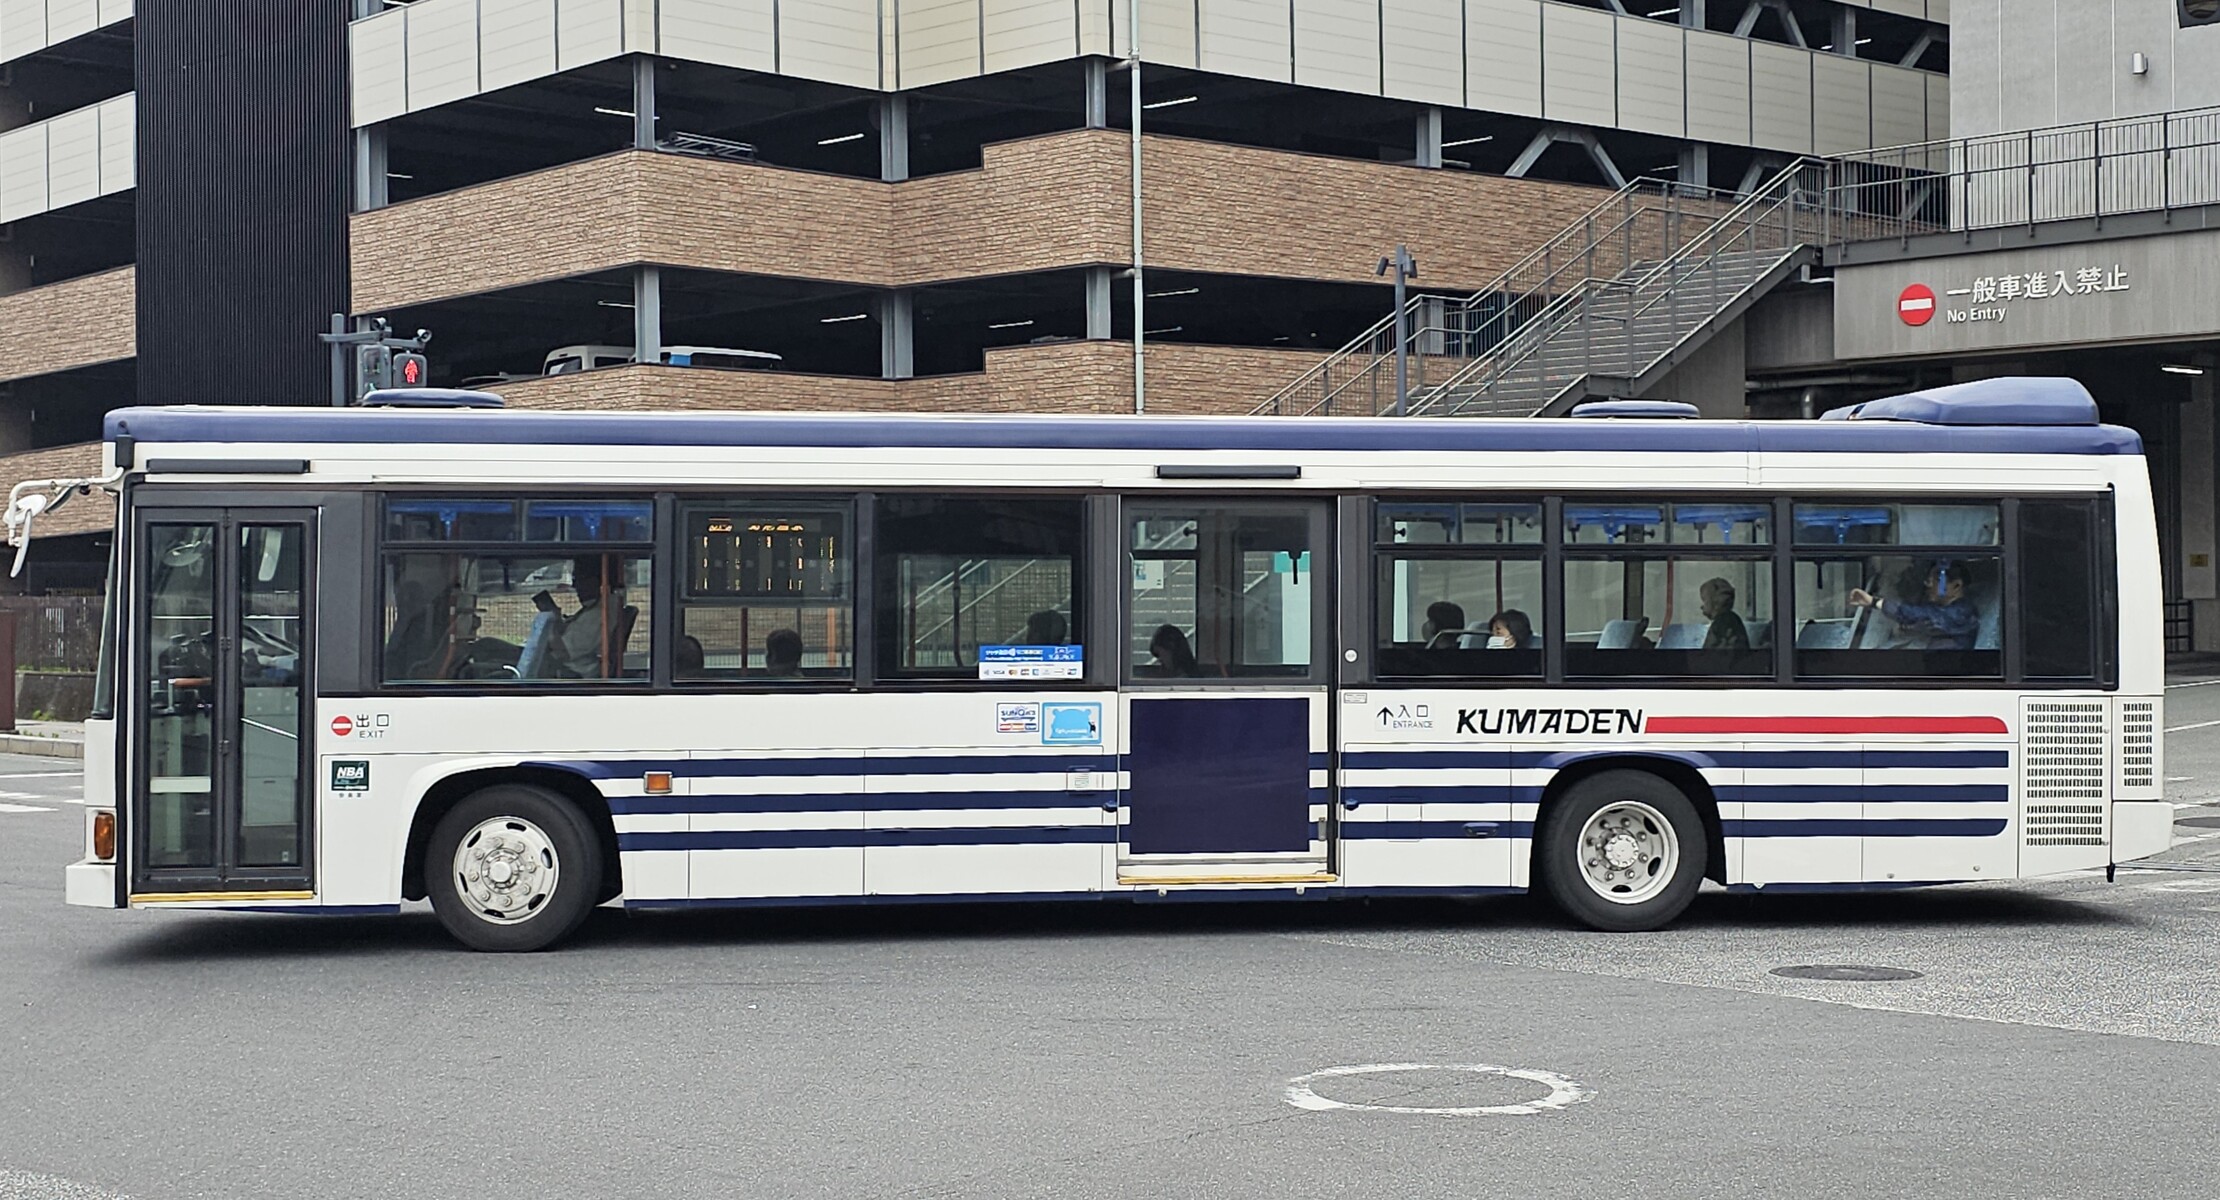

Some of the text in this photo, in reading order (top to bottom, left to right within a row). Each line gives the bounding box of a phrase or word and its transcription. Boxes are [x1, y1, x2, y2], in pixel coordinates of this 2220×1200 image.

[1946, 264, 2130, 304] 一般車進入禁止
[1946, 307, 2006, 323] No Entry
[1398, 705, 1428, 718] 入口
[356, 714, 389, 727] 出口
[1393, 720, 1433, 729] ENTRANCE
[1456, 708, 1642, 734] KUMADEN
[359, 730, 384, 738] EXIT
[337, 766, 364, 778] NBA
